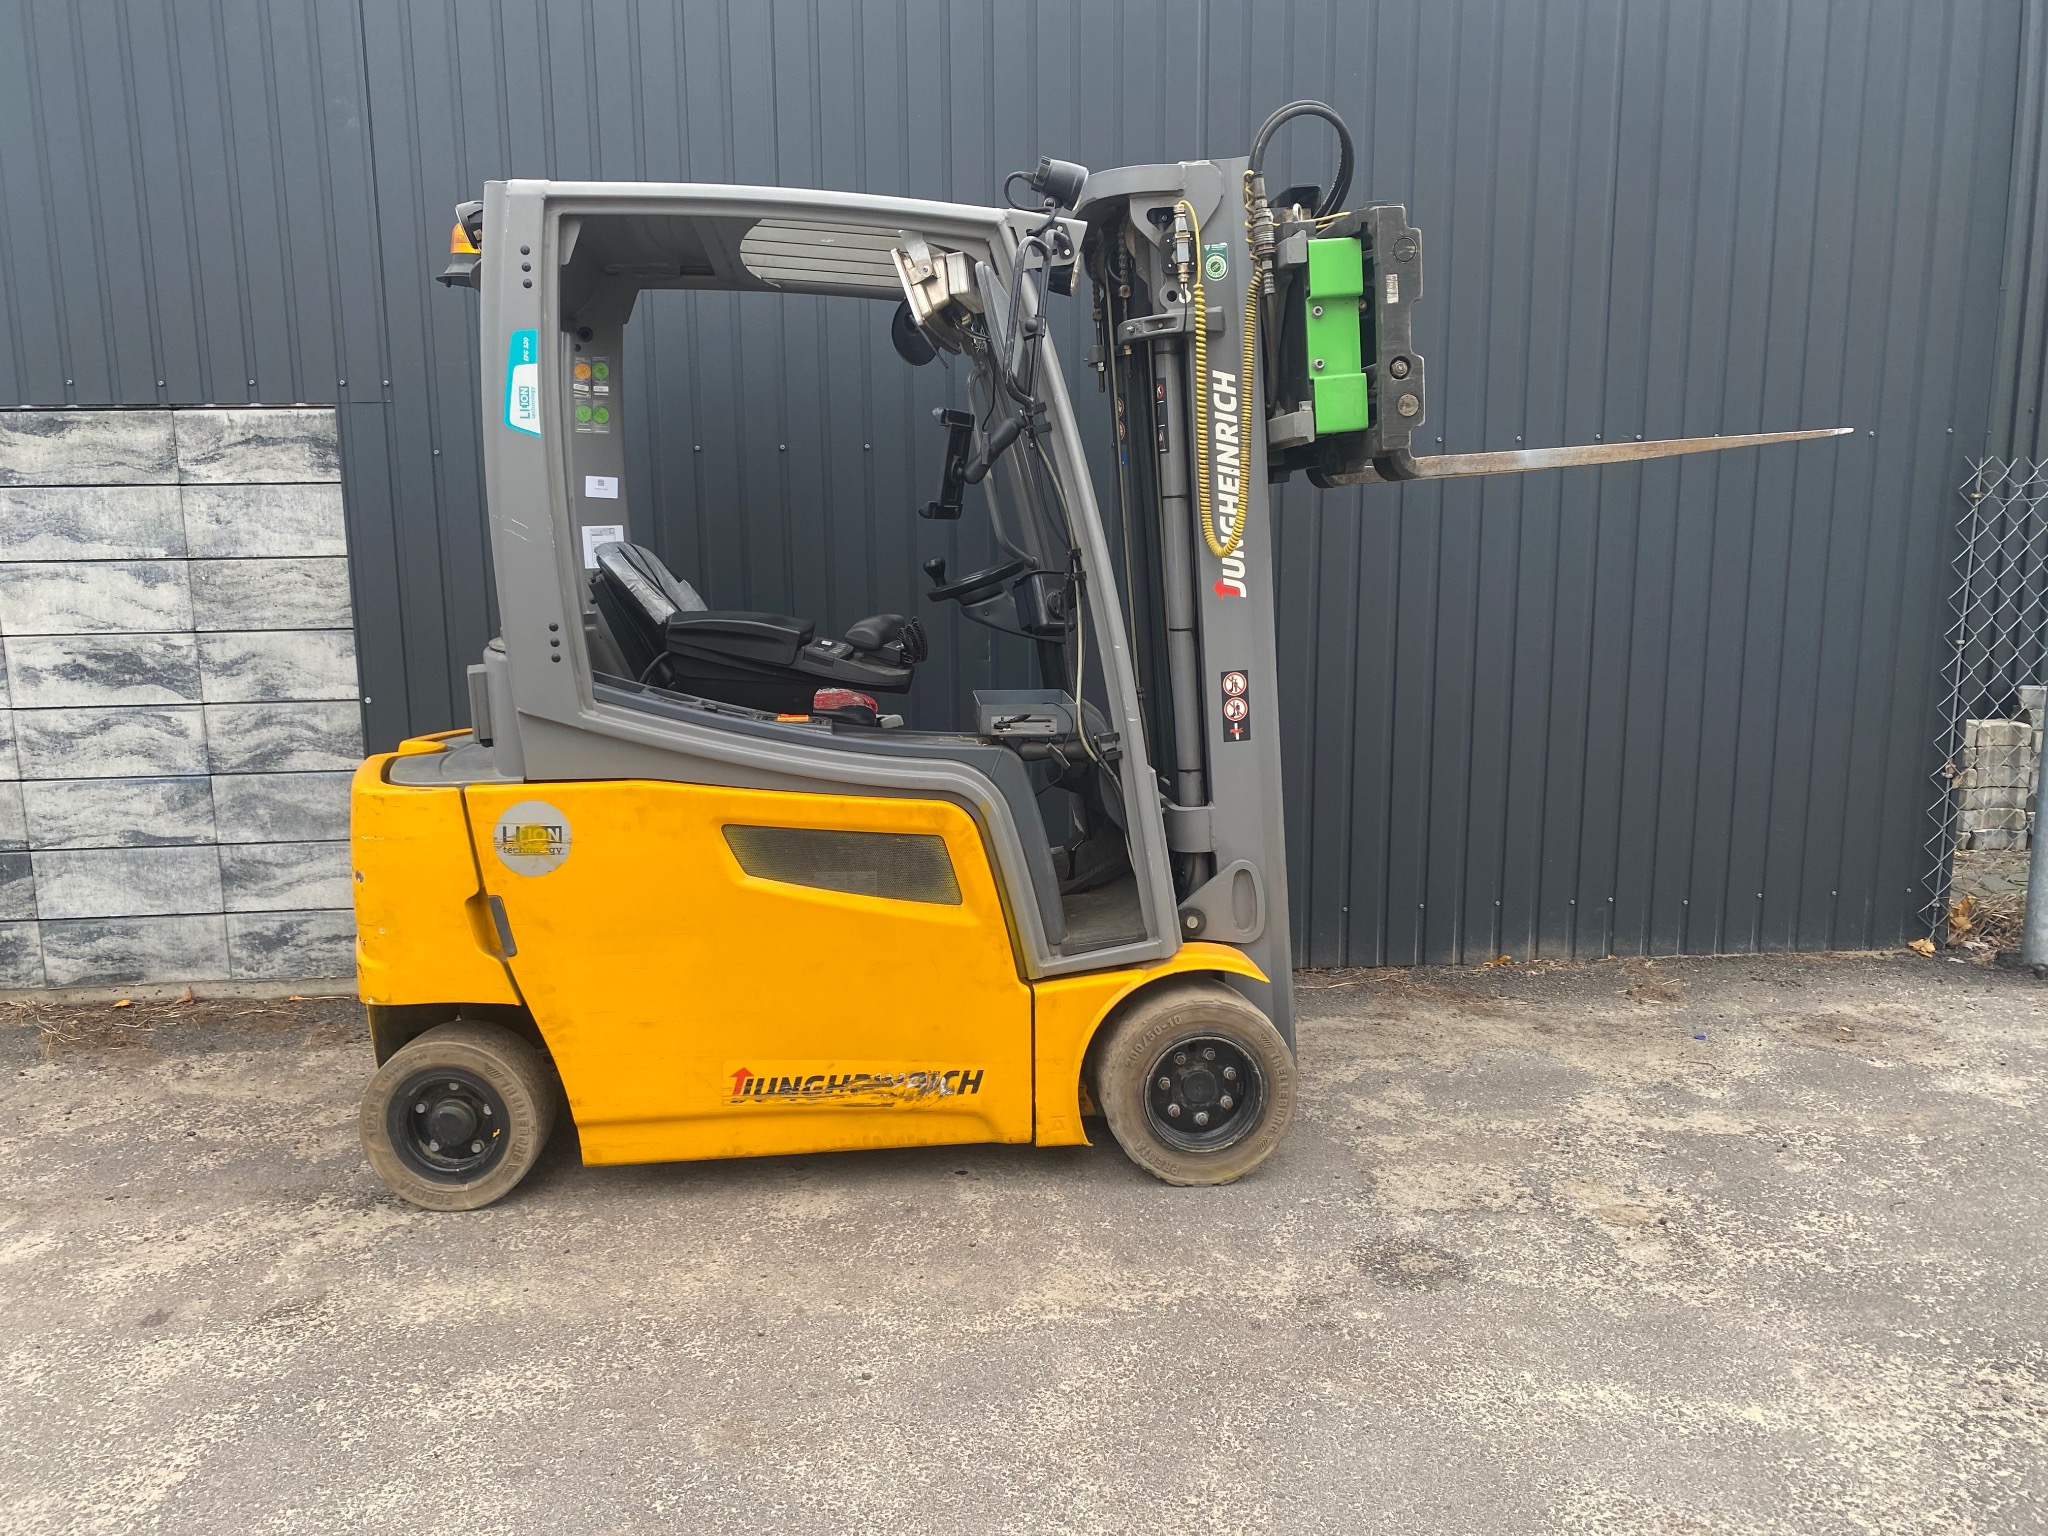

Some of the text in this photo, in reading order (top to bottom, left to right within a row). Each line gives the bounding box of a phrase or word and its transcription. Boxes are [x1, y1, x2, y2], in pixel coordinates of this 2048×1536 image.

[502, 846, 563, 856] technogy
[1125, 1014, 1182, 1068] 200/50-10
[1269, 1050, 1289, 1134] TRELLEBORG
[1135, 1140, 1181, 1175] PREMIA
